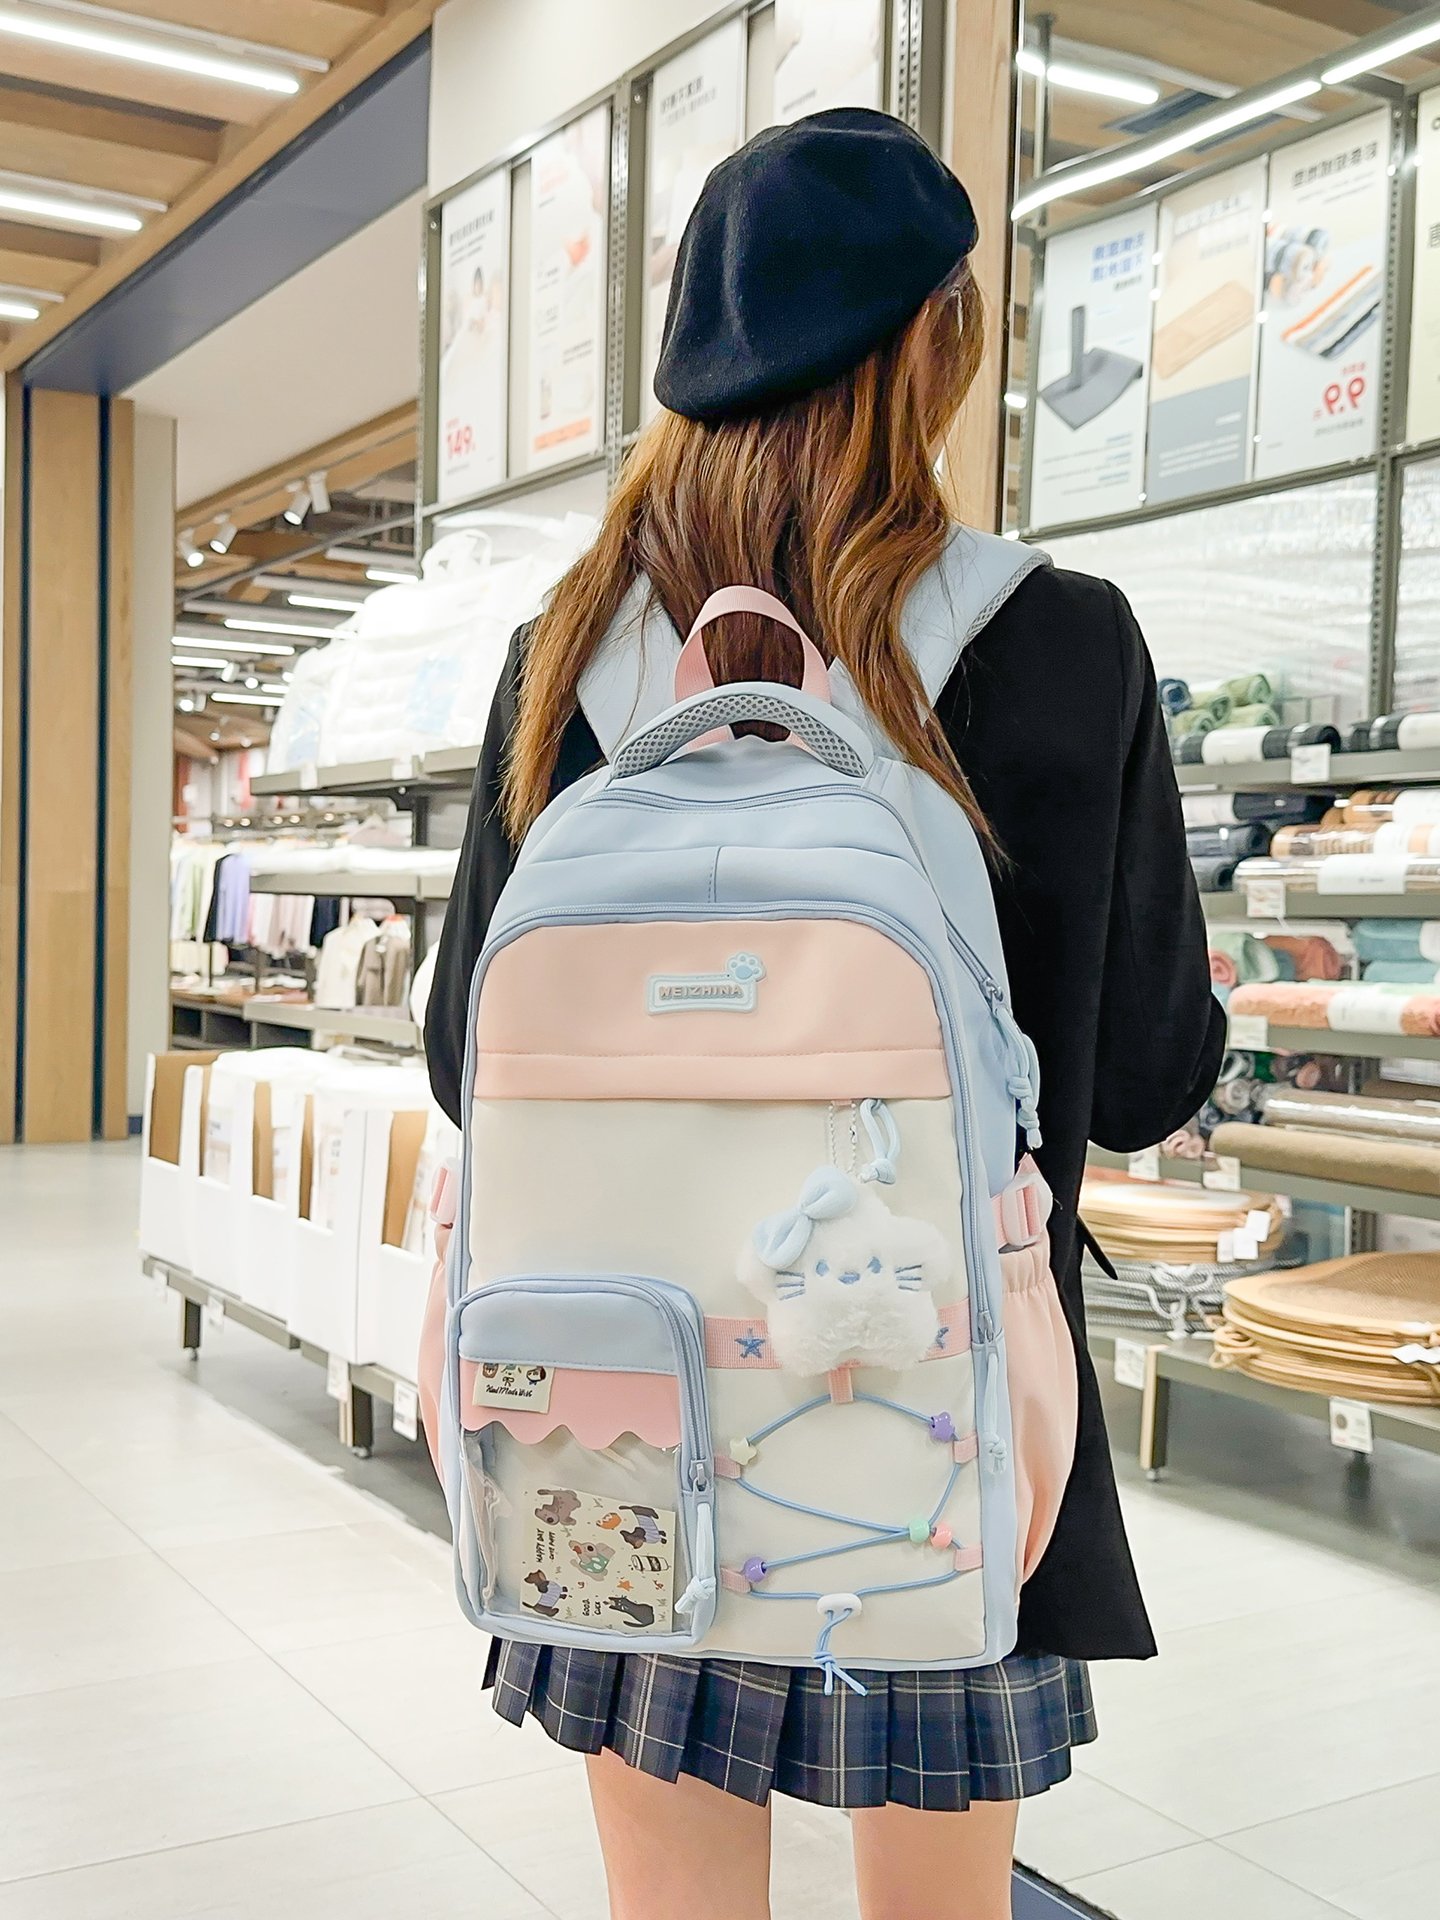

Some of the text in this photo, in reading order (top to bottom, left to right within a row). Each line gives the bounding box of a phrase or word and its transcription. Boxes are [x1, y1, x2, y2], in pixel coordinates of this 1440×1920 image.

[659, 985, 744, 1001] WEIZHINA
[535, 1528, 546, 1563] HAPPY DAY
